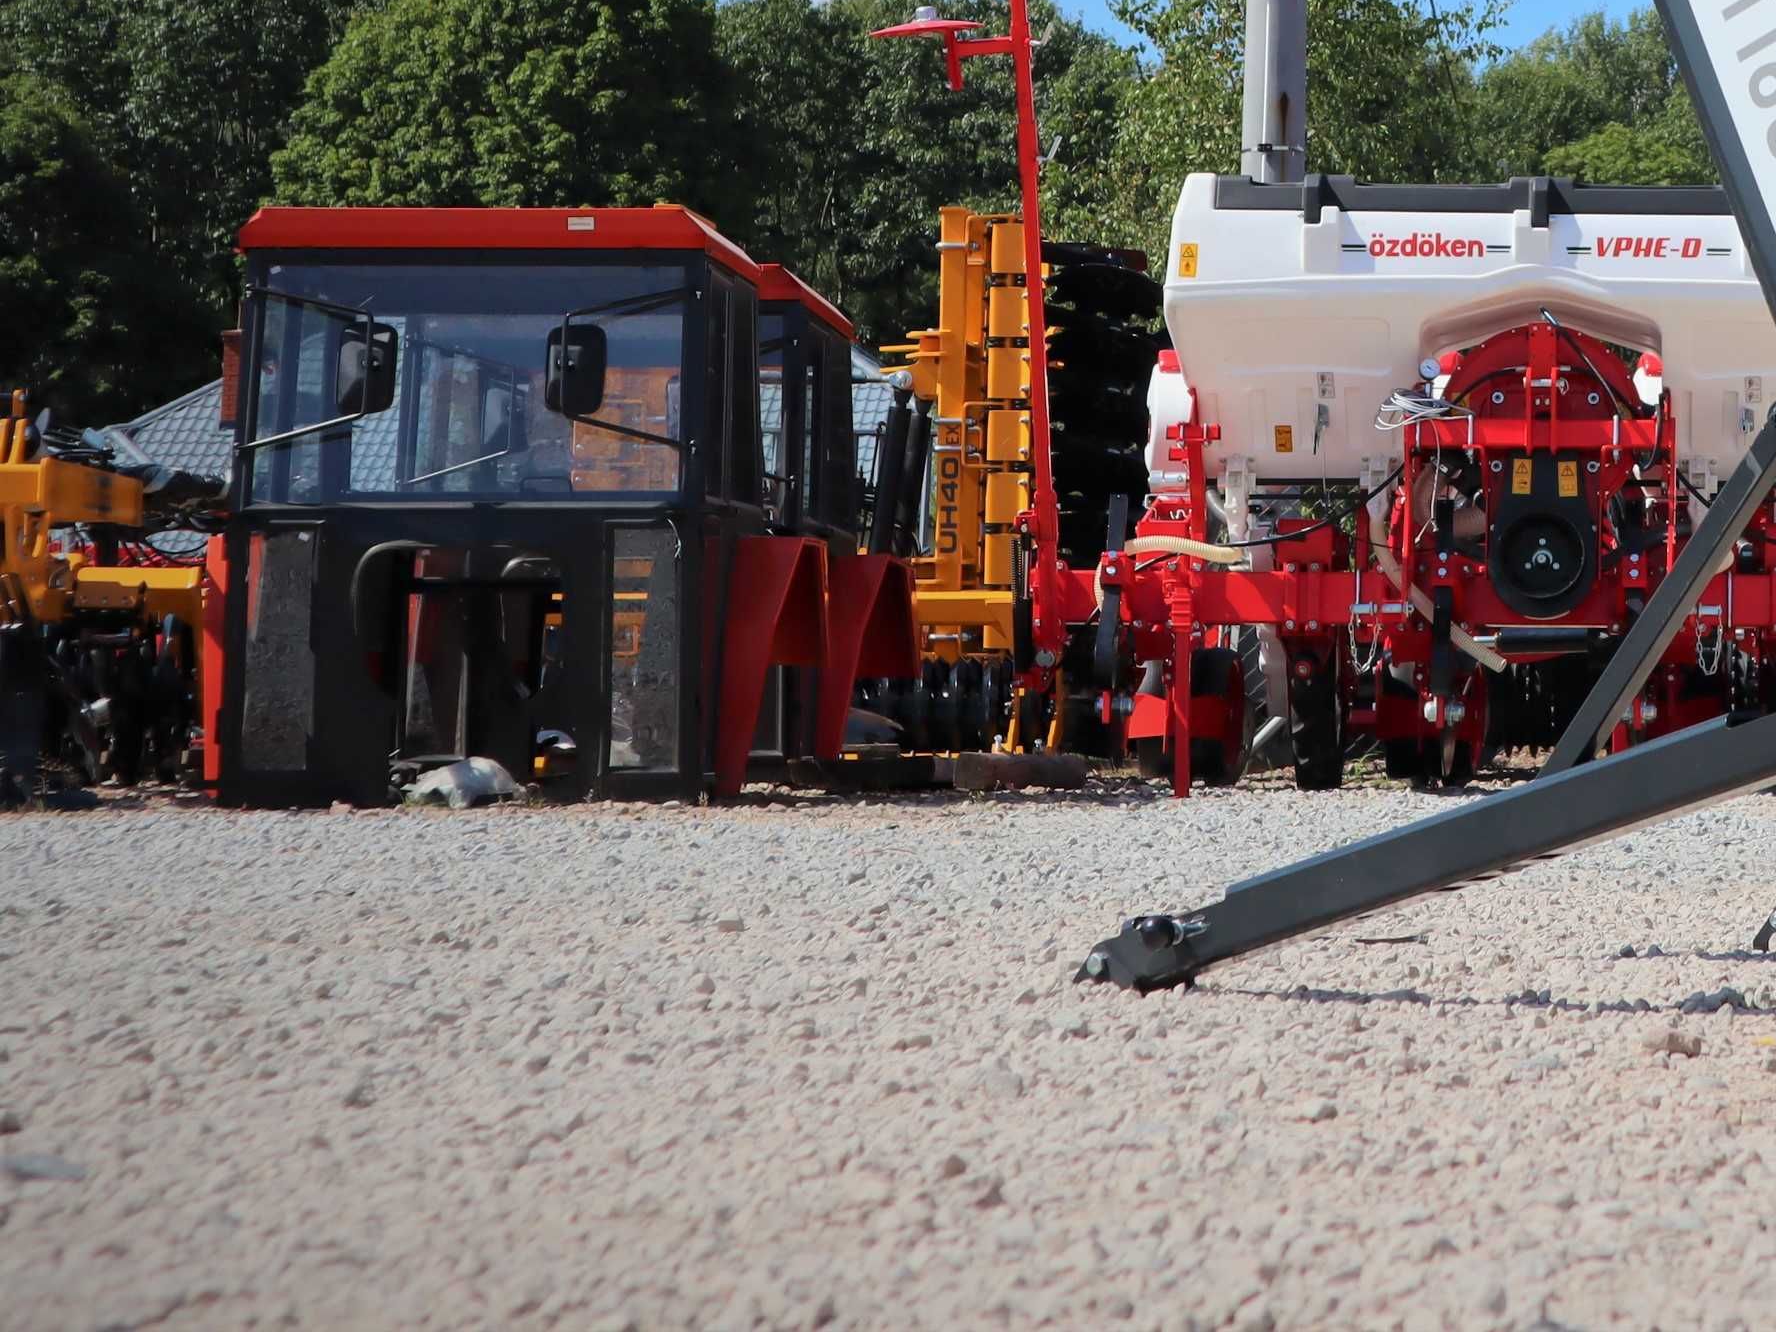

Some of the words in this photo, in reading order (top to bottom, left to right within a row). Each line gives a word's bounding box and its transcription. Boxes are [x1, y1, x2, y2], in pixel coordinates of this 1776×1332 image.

[1369, 232, 1485, 258] özdöken
[1596, 237, 1702, 259] VPHE-D
[945, 426, 960, 445] EX
[940, 457, 960, 554] UH40
